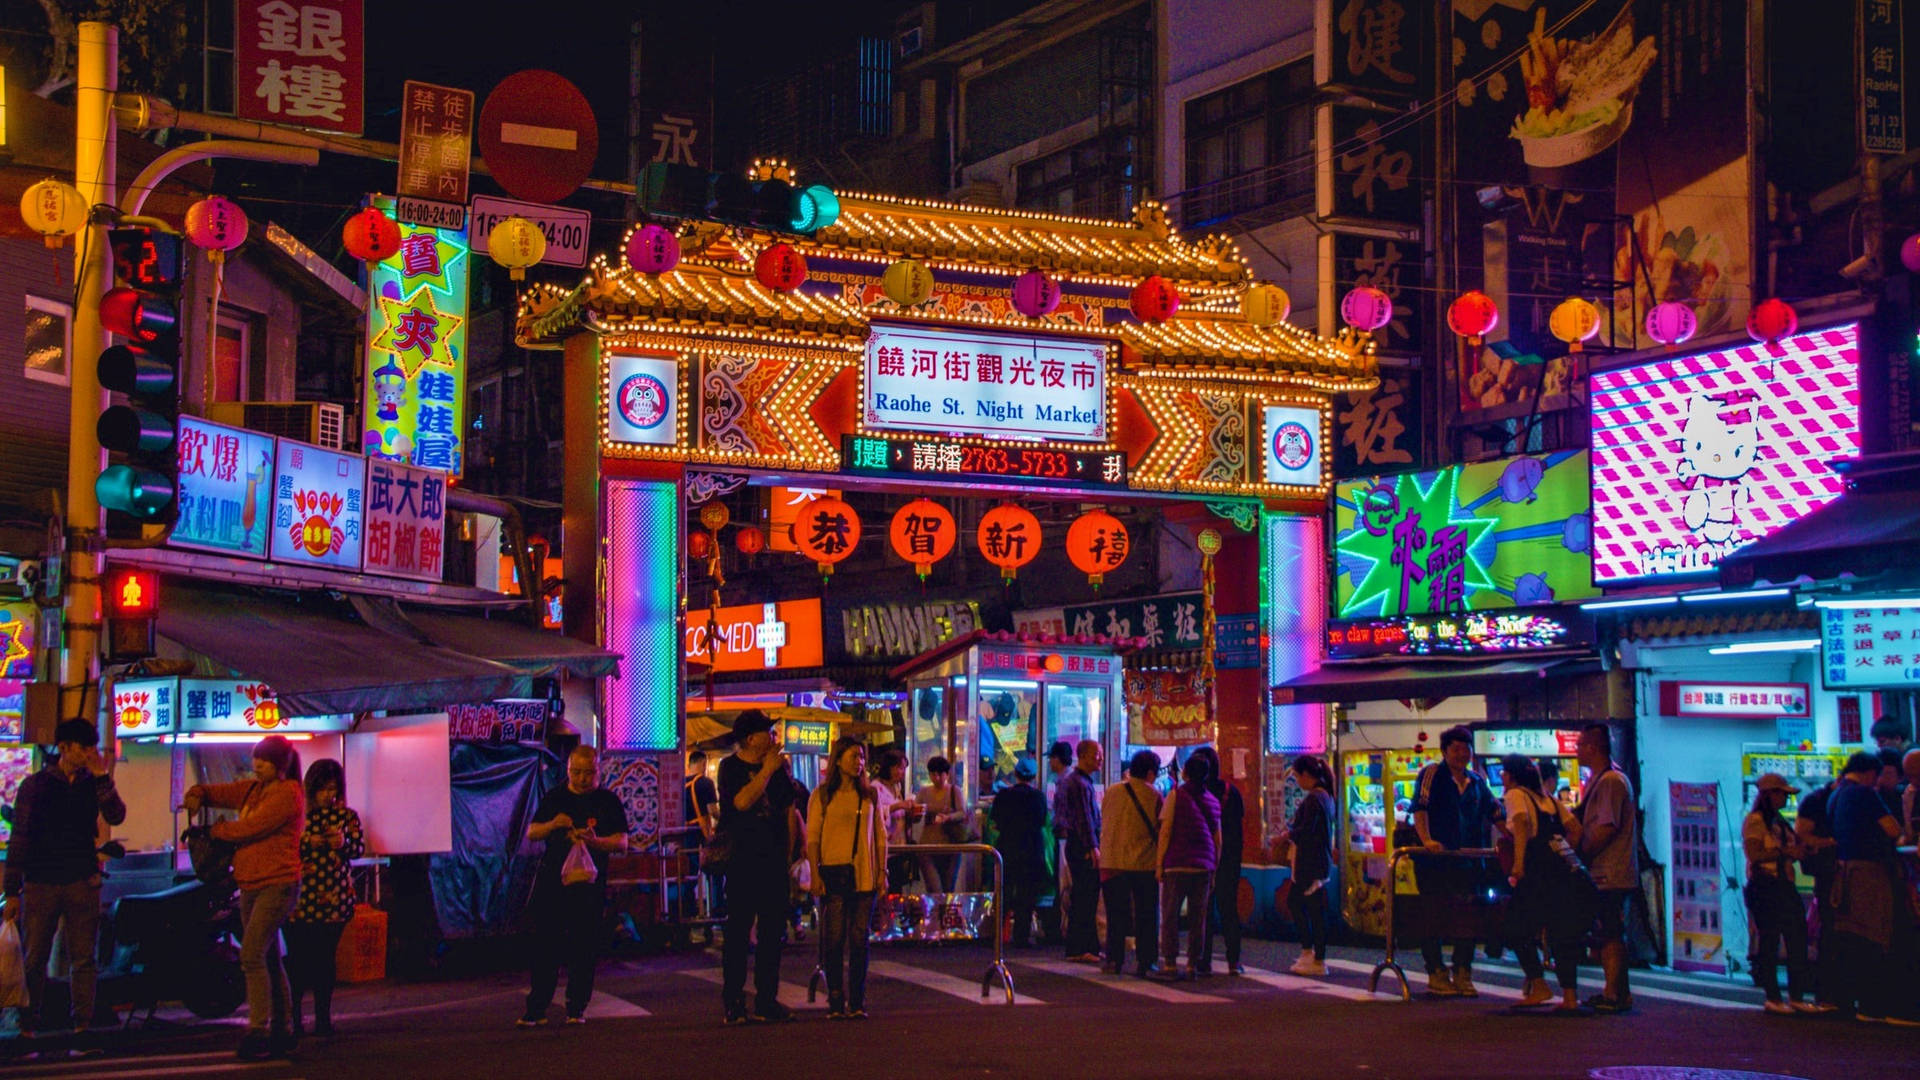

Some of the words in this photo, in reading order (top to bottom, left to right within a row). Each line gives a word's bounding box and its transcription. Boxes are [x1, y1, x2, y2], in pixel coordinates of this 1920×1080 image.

[255, 1, 346, 122] 銀樓
[407, 89, 436, 191] 禁止停車
[438, 94, 465, 196] 徒步區內
[400, 201, 462, 227] 16:00-24:00
[876, 345, 1096, 391] 饒河街觀光夜市
[416, 370, 456, 470] 娃娃屋
[875, 392, 931, 413] Raohe
[942, 397, 964, 416] St.
[976, 400, 1024, 422] Night
[1035, 404, 1098, 424] Market
[369, 465, 442, 522] 武大郎
[367, 517, 441, 573] 胡椒餅
[1641, 541, 1719, 576] HELLO
[1347, 626, 1370, 642] claw
[1374, 627, 1403, 645] games
[1413, 626, 1429, 640] on
[1437, 620, 1456, 639] the
[1465, 617, 1488, 637] 2nd
[1683, 691, 1724, 705] 台灣製造
